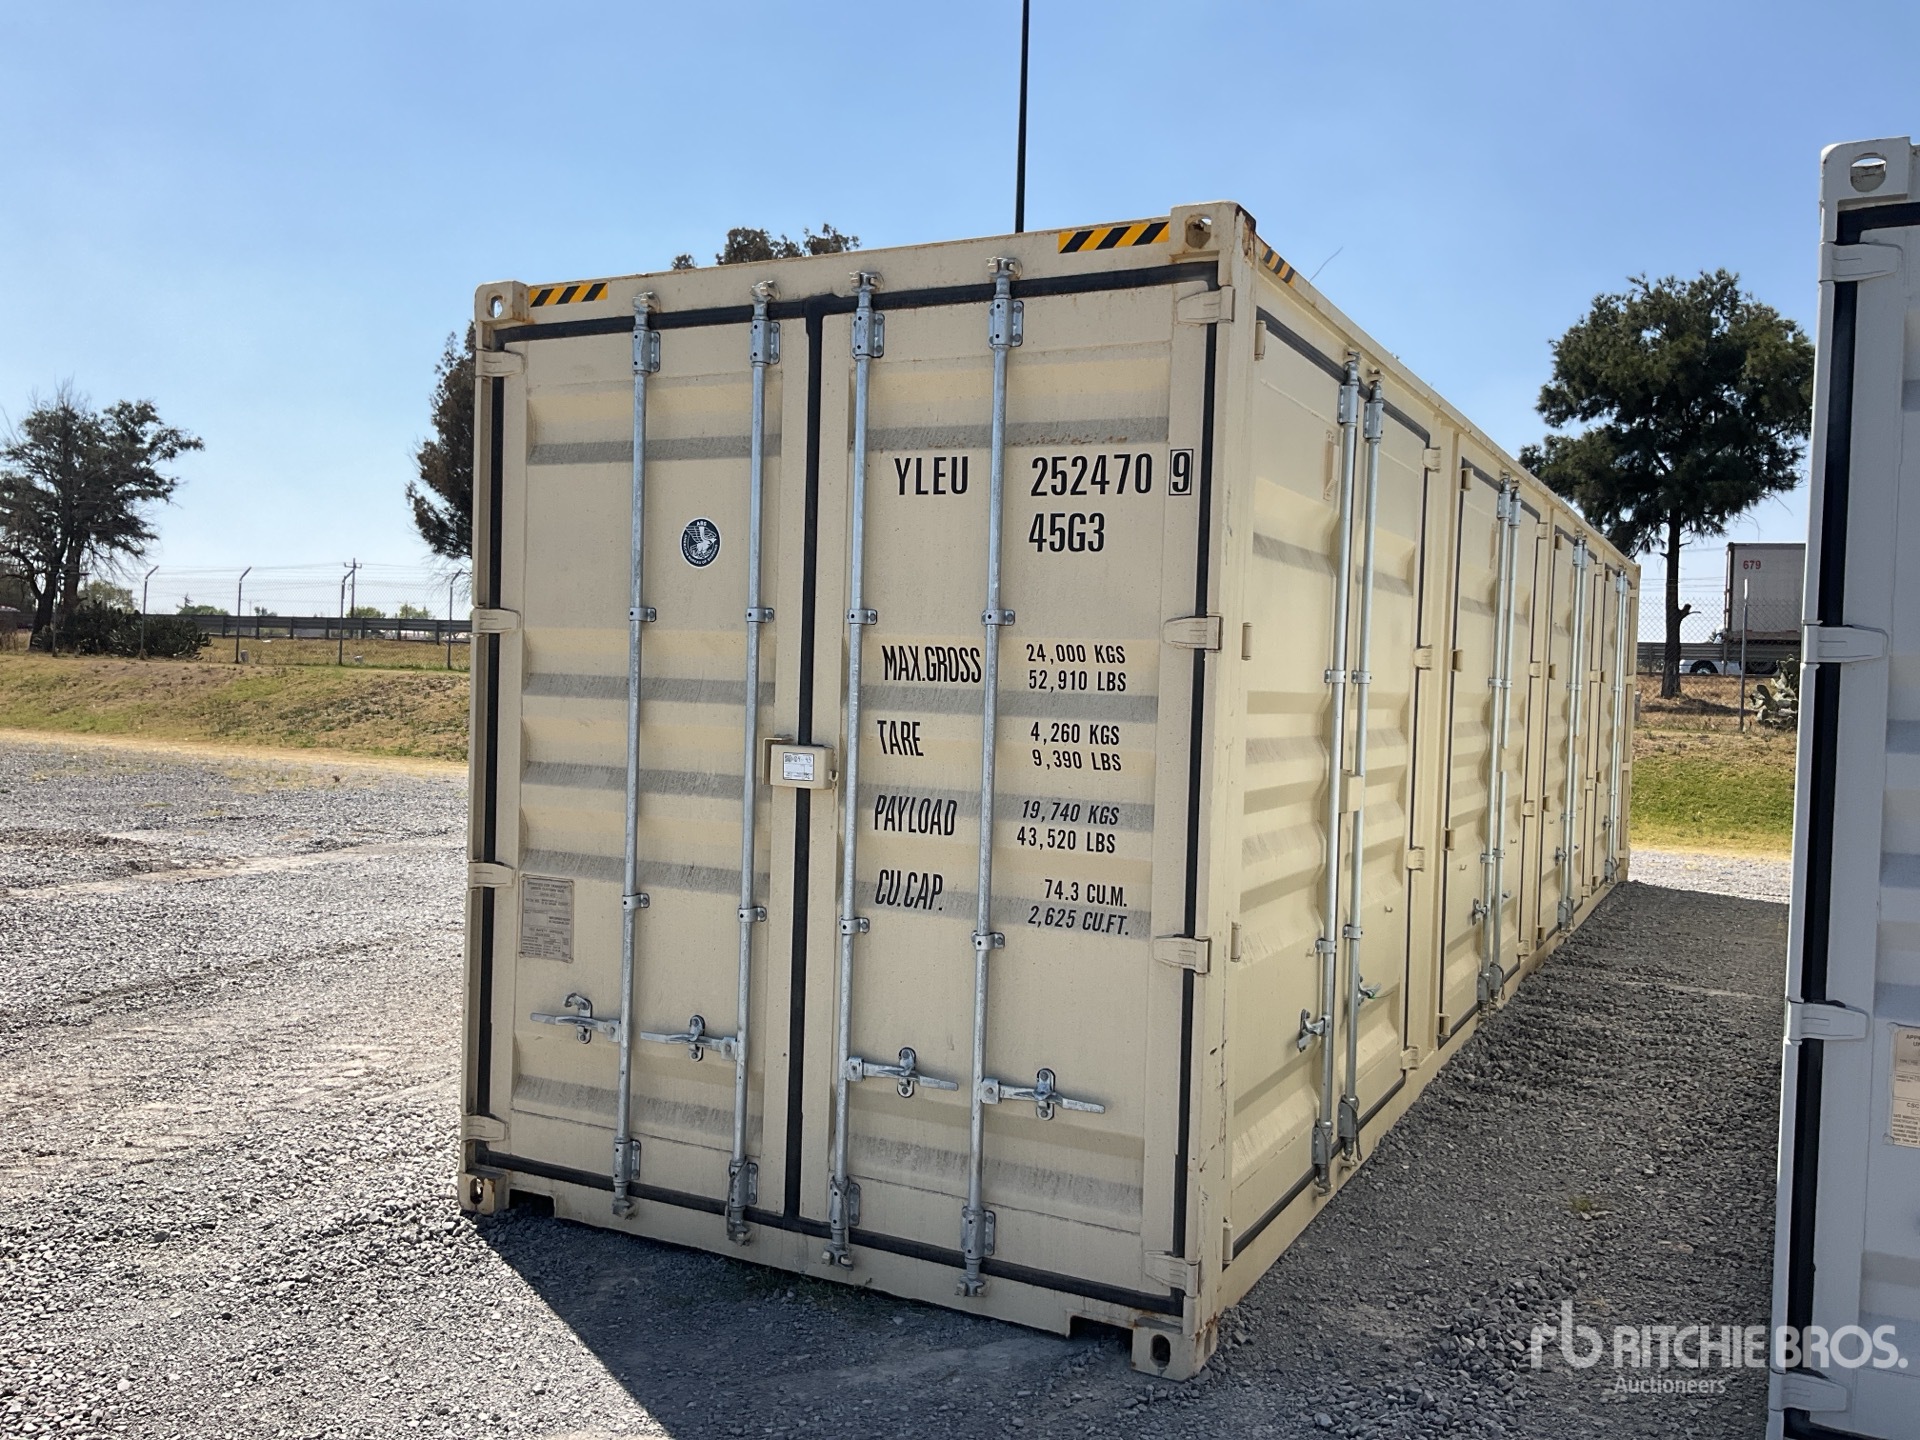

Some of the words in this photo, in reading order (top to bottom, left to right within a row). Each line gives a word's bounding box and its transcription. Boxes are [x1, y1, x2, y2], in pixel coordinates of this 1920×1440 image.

[894, 456, 969, 496] YLEU
[1030, 453, 1153, 497] 252470
[1172, 451, 1191, 493] 9
[1028, 512, 1105, 553] 45G3
[1742, 560, 1761, 570] 679
[881, 645, 982, 684] MAX.GROSS
[1026, 643, 1086, 665] 24,000
[1094, 644, 1126, 664] KGS
[1029, 669, 1088, 693] 52,910
[1097, 671, 1127, 692] LBS
[876, 719, 924, 757] TARE
[1030, 721, 1081, 746] 4,260
[1089, 724, 1120, 746] KGS
[1032, 749, 1083, 770] 9,390
[1091, 752, 1122, 772] LBS
[874, 794, 958, 836] PAYLOAD
[1022, 799, 1081, 823] 19,740
[1087, 804, 1120, 826] KGS
[1016, 826, 1076, 851] 43,520
[1086, 831, 1116, 854] LBS
[874, 869, 943, 911] CU.CAP.
[1044, 878, 1079, 902] 74.3
[1086, 883, 1127, 908] CU.M.
[1027, 905, 1077, 929] 2,625
[1082, 911, 1129, 936] CU.FT.
